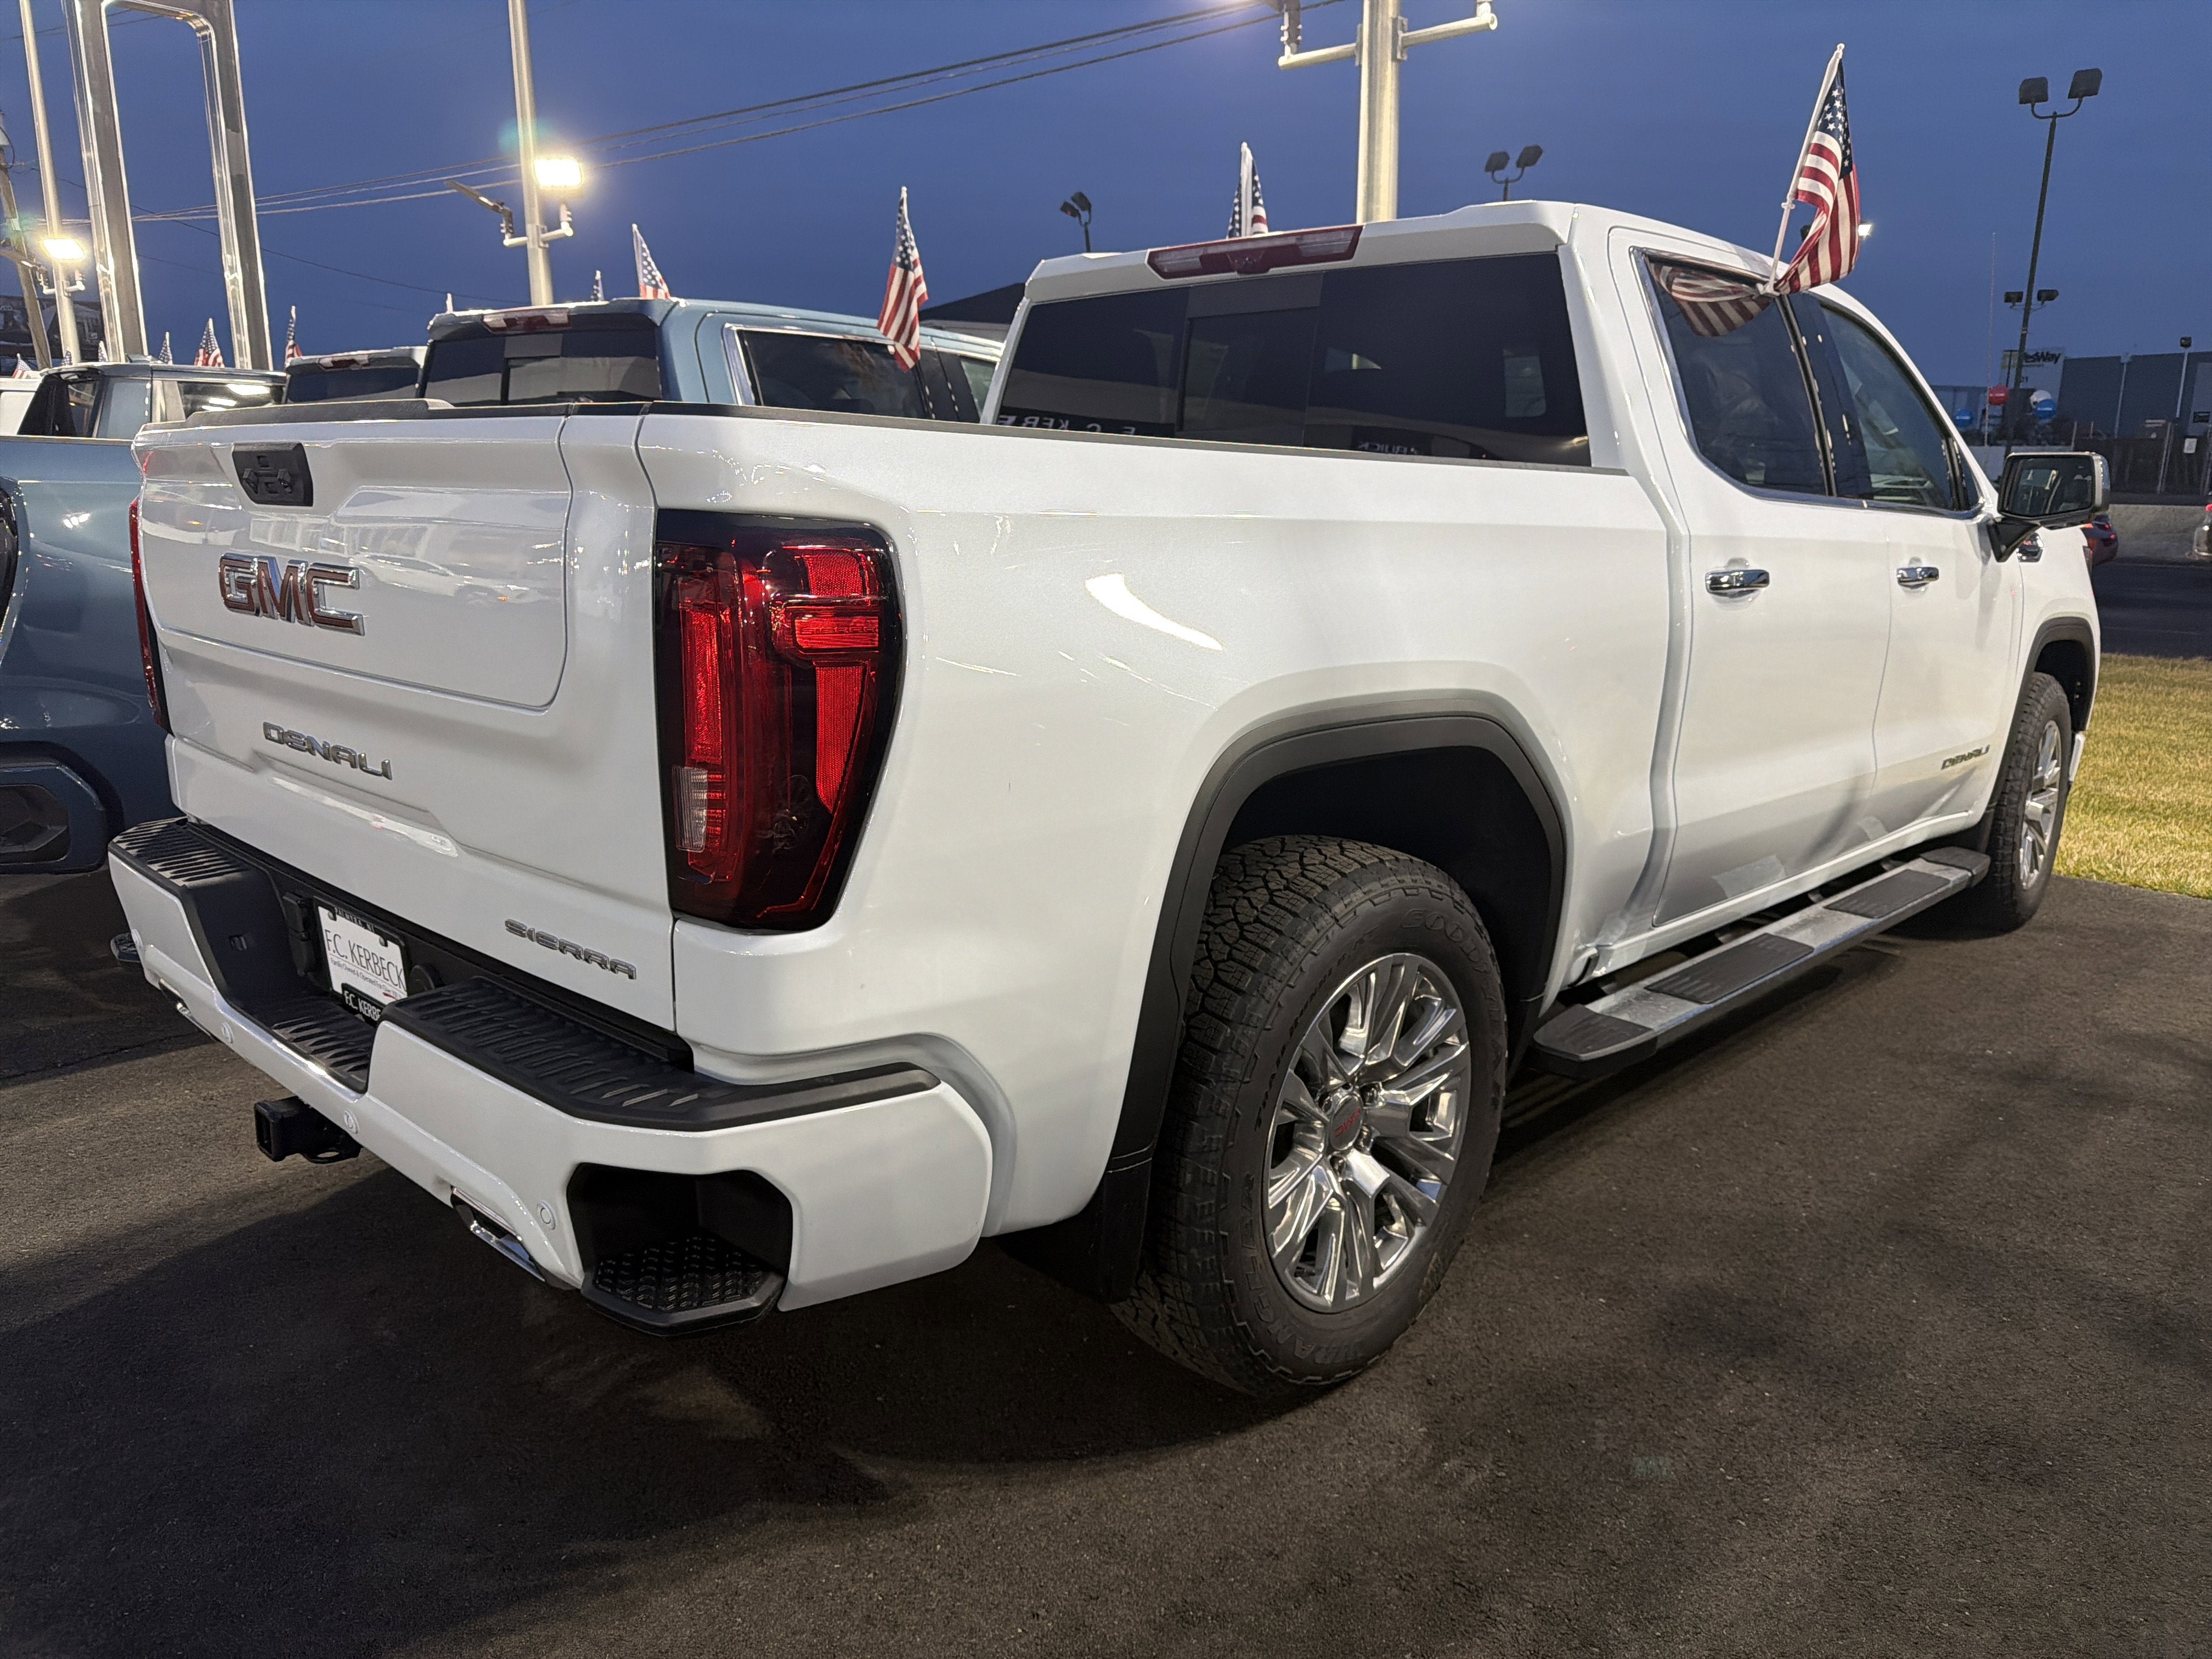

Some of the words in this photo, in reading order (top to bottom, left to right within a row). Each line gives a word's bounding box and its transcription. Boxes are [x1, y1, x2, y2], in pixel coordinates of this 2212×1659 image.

[219, 552, 365, 636] GMC
[263, 721, 393, 780] DENALI
[324, 929, 348, 960] F.C.
[348, 940, 407, 991] KERBECK
[505, 918, 636, 980] SIERRA
